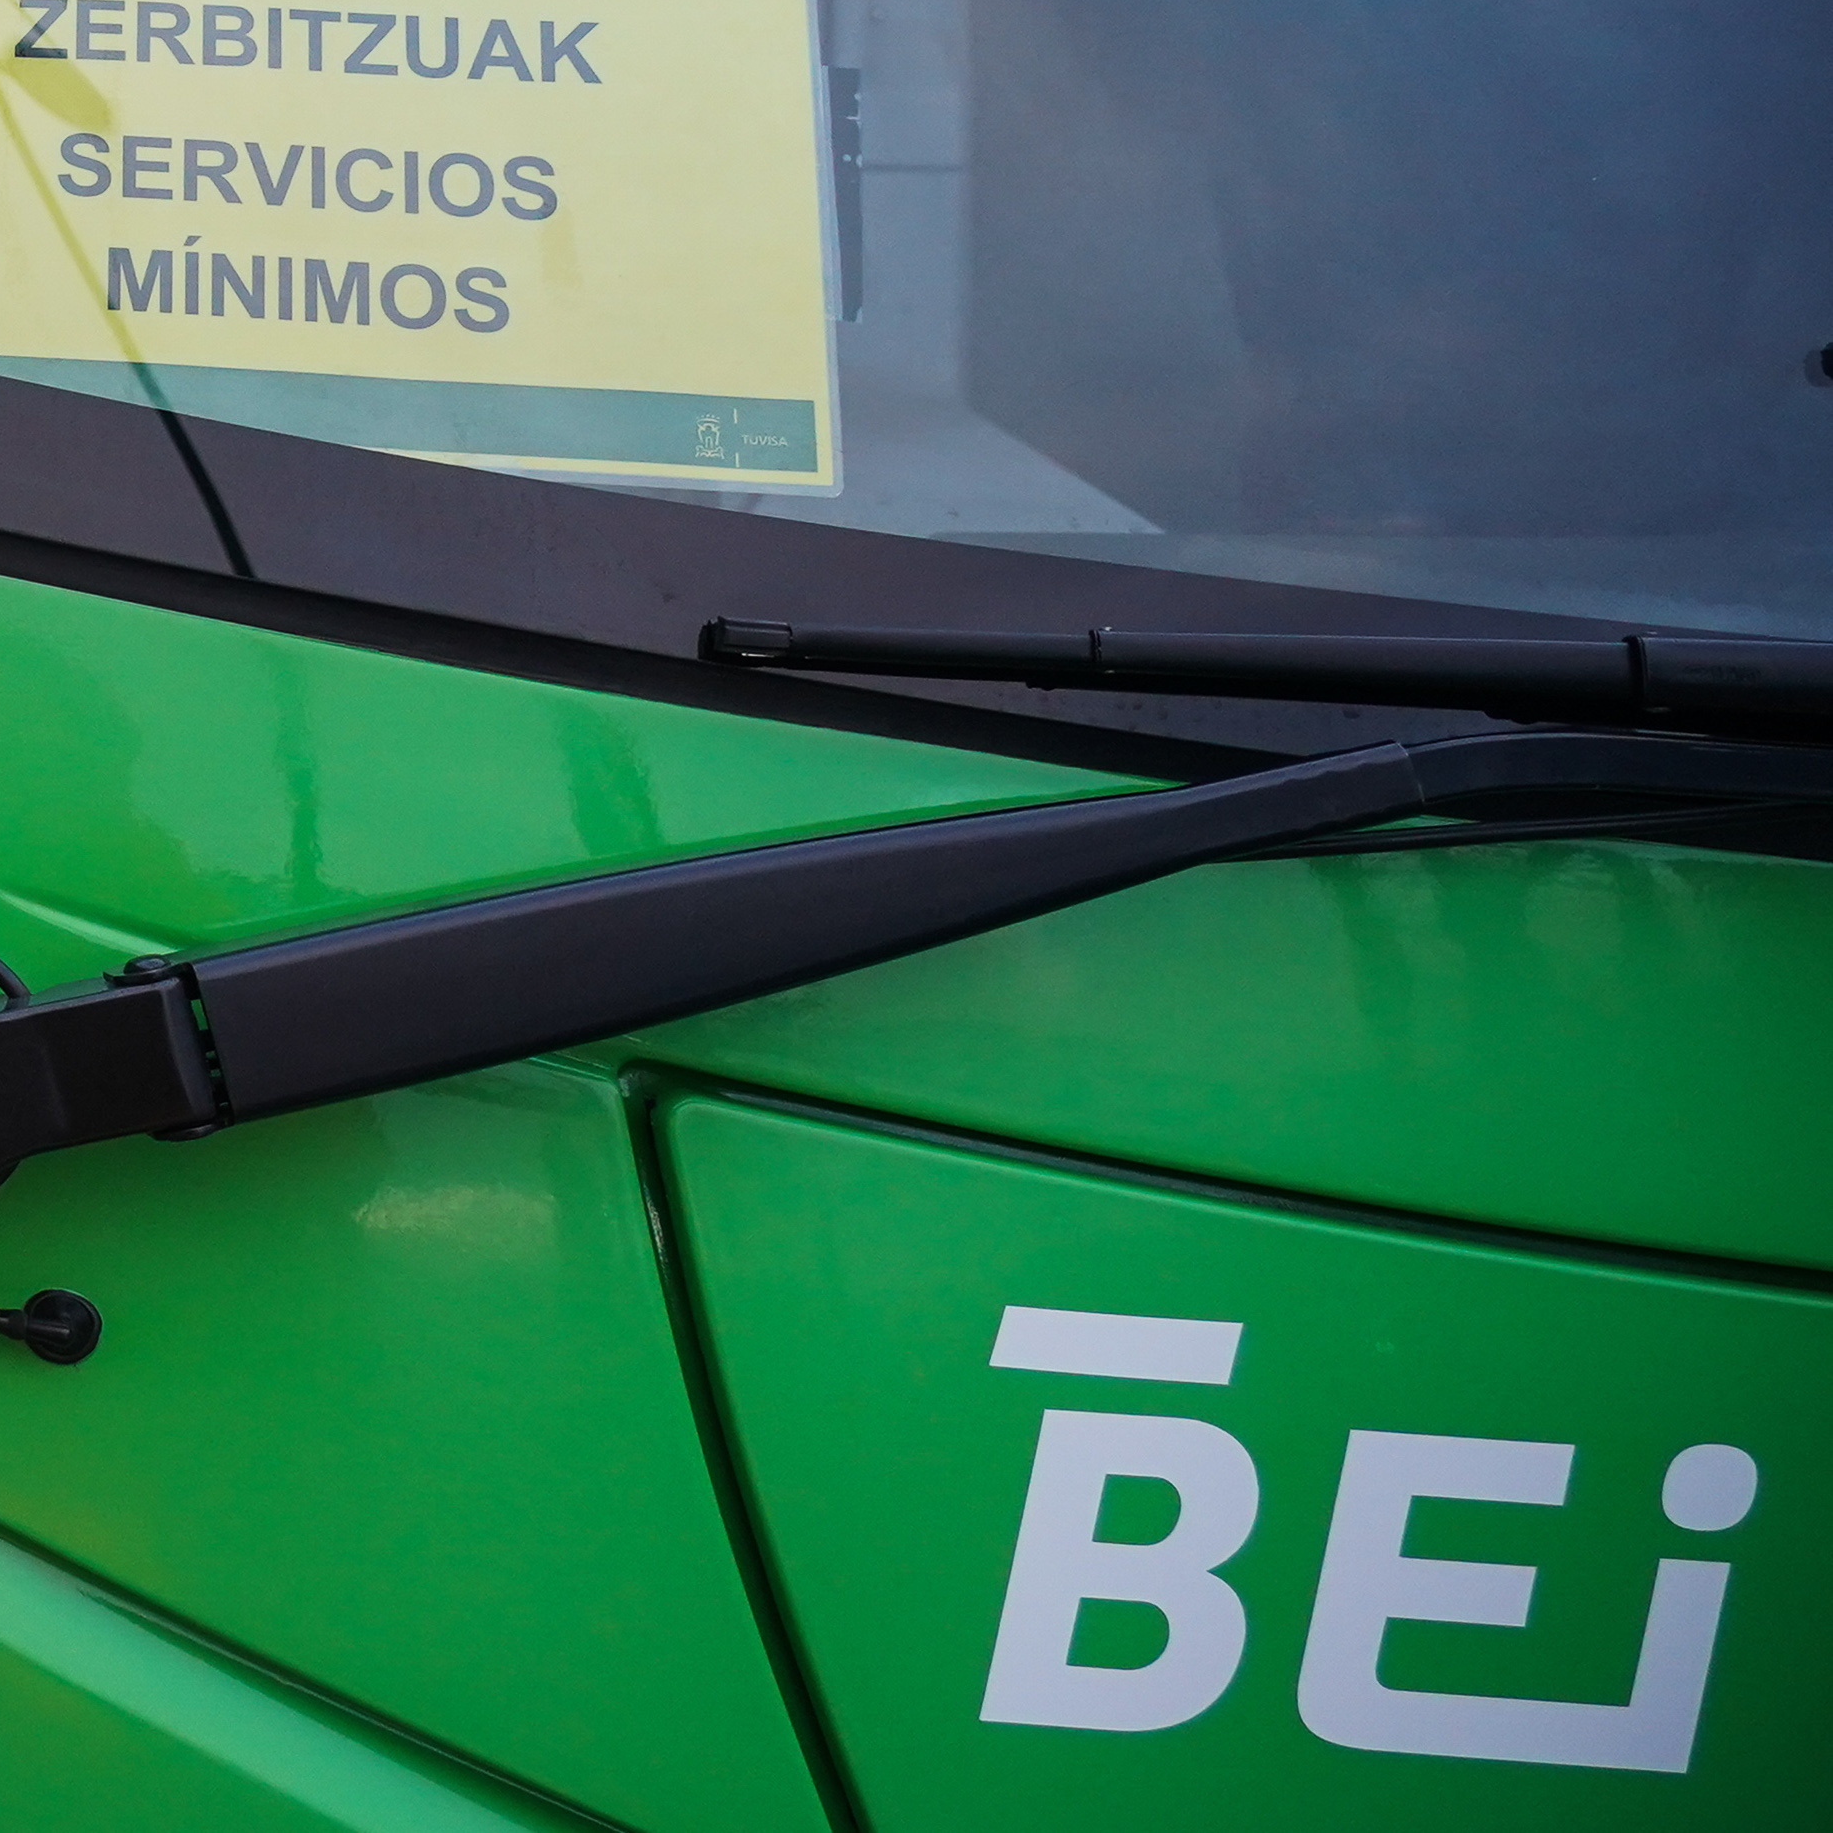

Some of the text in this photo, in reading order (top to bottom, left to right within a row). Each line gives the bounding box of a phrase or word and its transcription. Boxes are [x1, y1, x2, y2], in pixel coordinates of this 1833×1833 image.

[57, 132, 558, 221] SERVICIOS
[106, 235, 510, 334] MÍNIMOS
[741, 434, 789, 447] TUVISA
